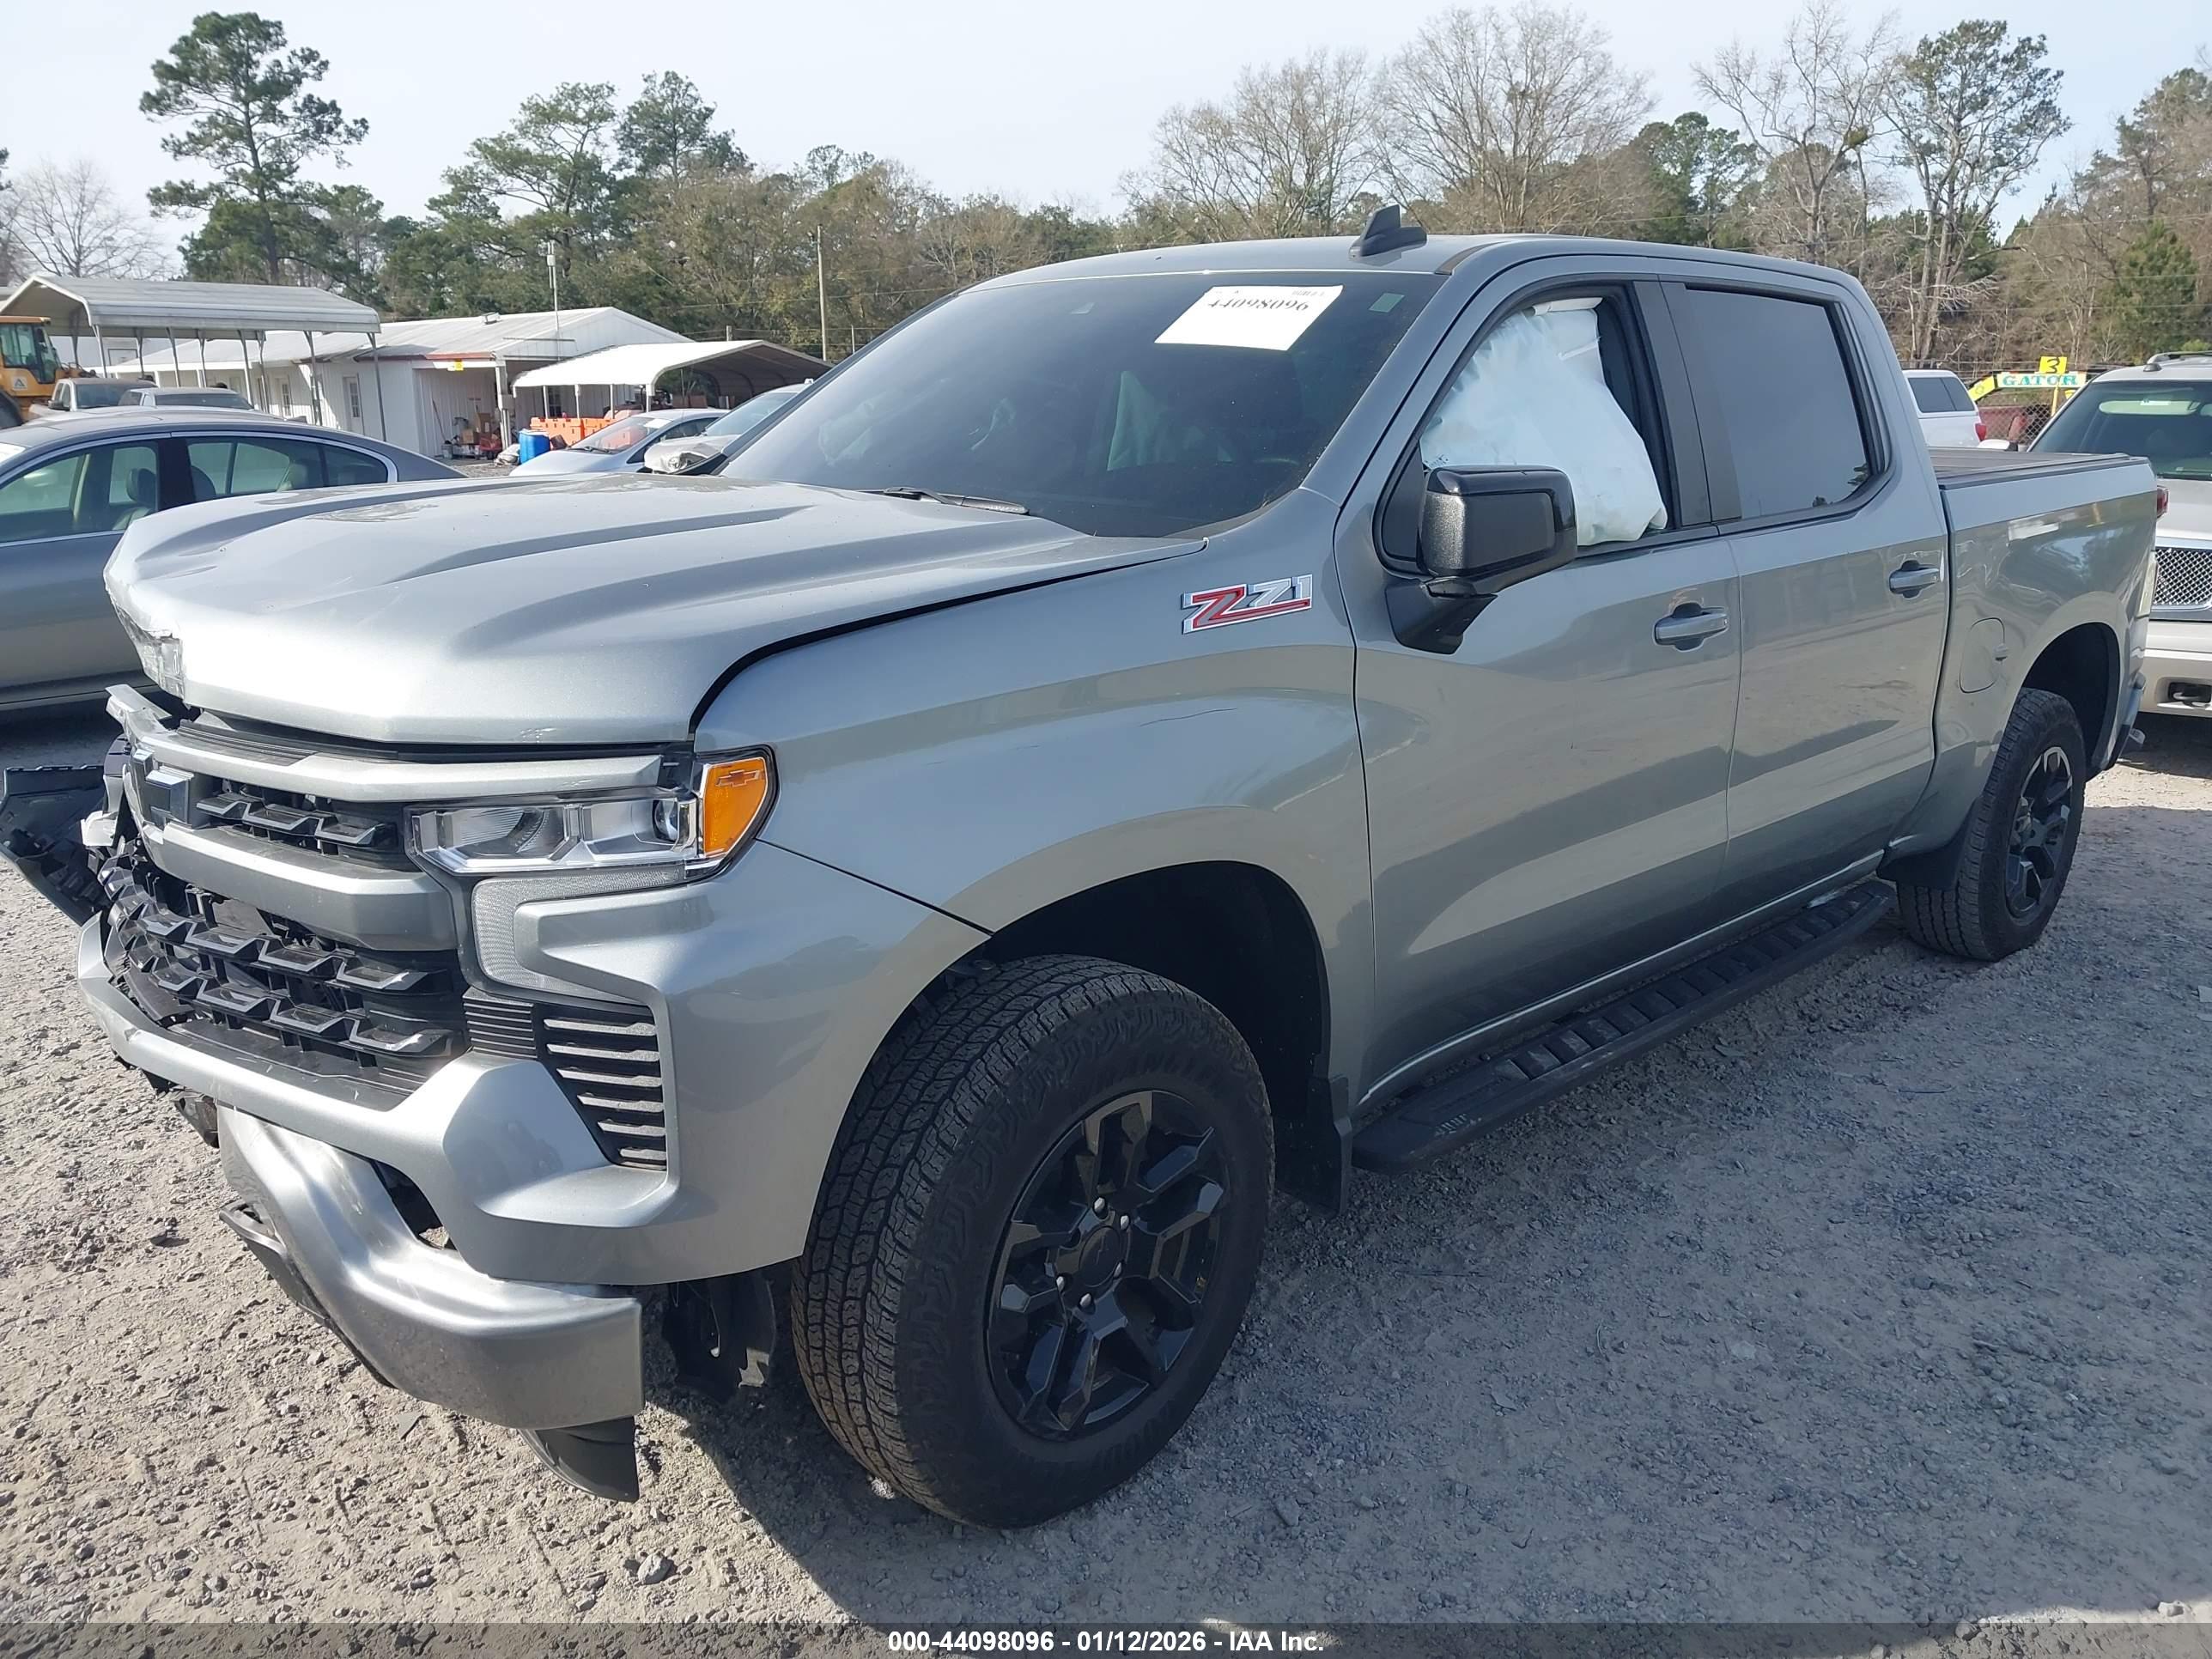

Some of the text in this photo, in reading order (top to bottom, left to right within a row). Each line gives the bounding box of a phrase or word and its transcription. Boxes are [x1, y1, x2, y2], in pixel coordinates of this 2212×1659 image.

[2046, 357, 2061, 374] 3
[2002, 374, 2078, 386] GATOR
[1182, 574, 1313, 635] Z71
